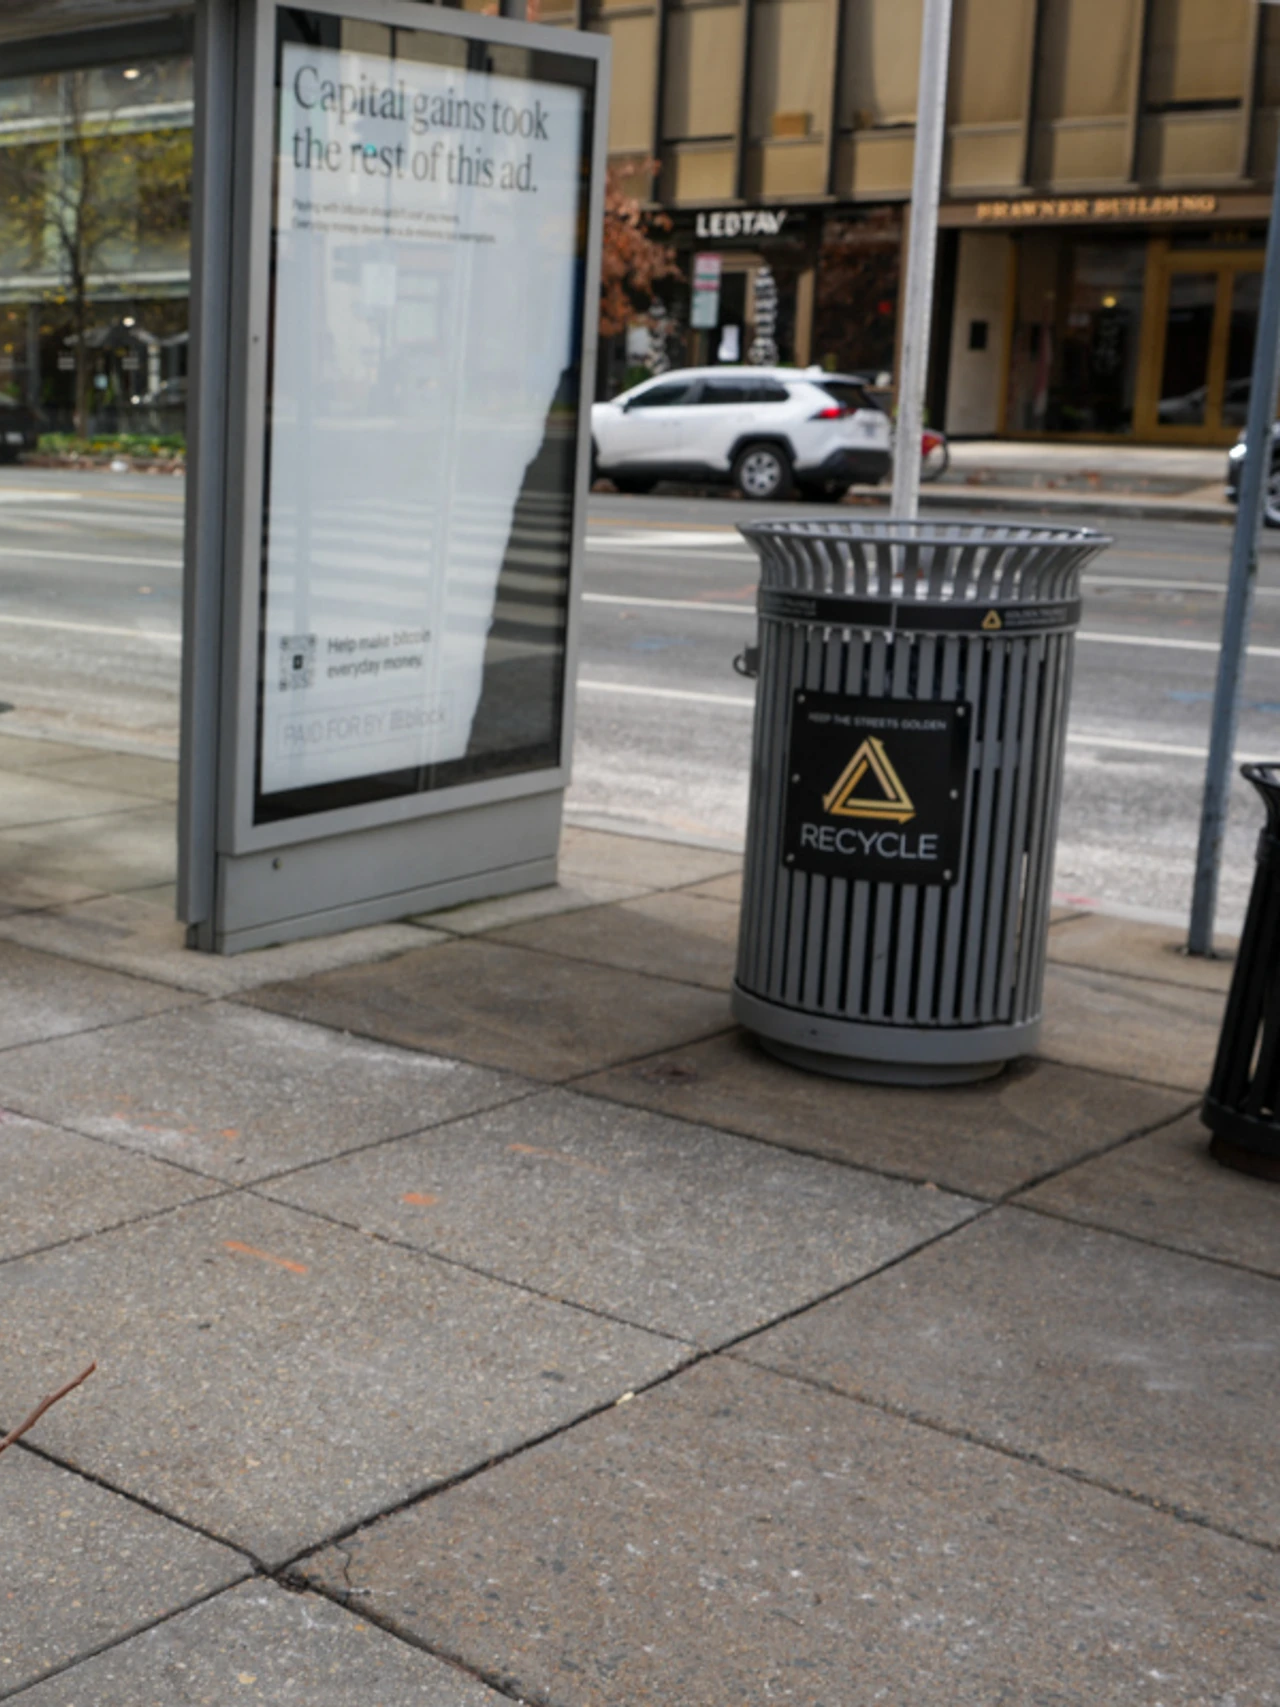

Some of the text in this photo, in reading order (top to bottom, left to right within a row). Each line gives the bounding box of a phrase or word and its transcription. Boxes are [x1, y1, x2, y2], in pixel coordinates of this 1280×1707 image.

[293, 65, 550, 141] Capital gains took
[292, 126, 539, 193] the rest of this ad.
[327, 658, 380, 679] everyday
[326, 715, 361, 740] FOR
[364, 713, 384, 735] BY
[853, 716, 899, 729] STREETS
[901, 718, 947, 731] GOLDEN
[801, 822, 939, 861] RECYCLE
